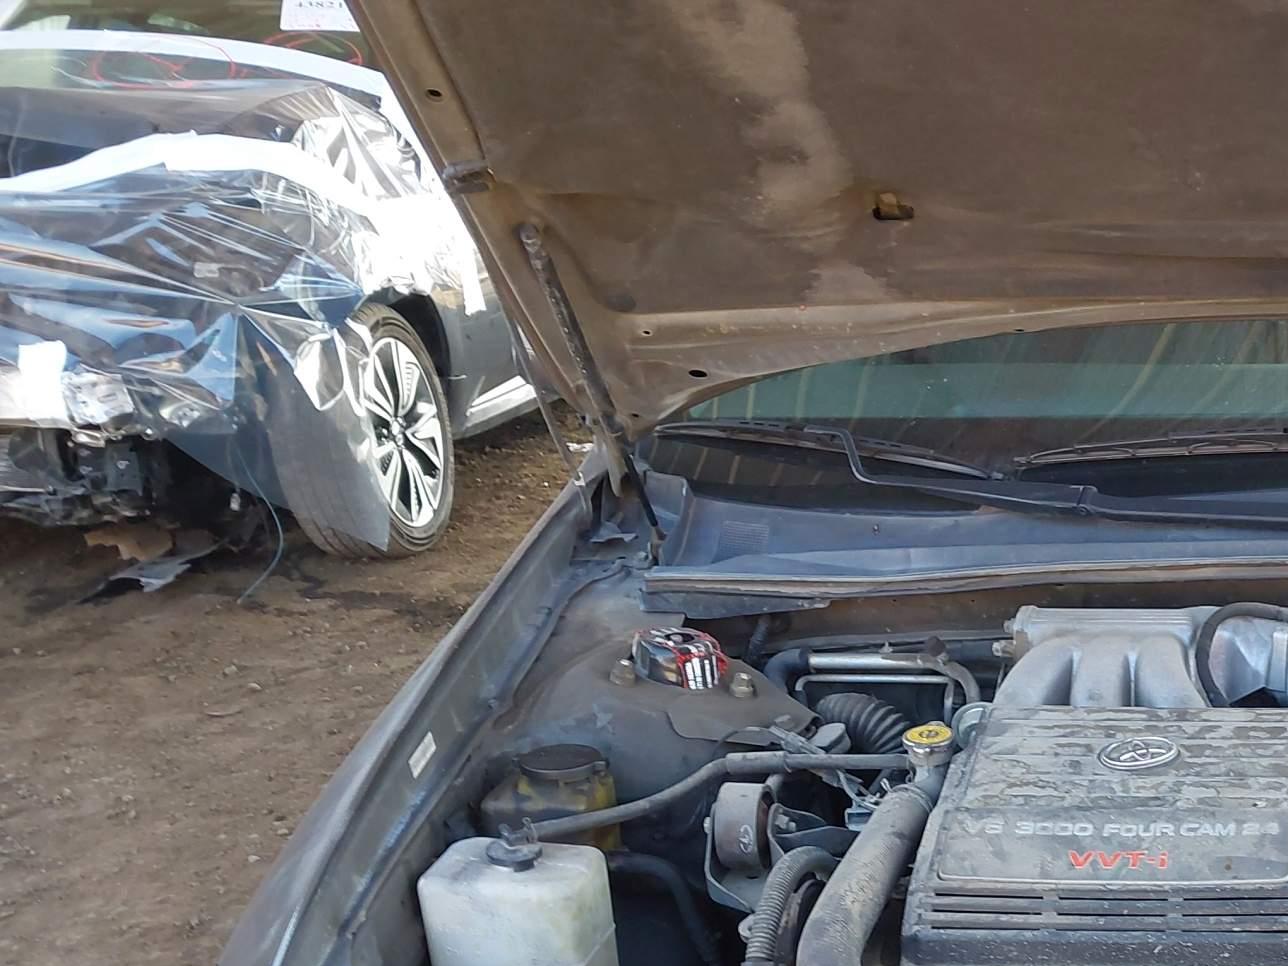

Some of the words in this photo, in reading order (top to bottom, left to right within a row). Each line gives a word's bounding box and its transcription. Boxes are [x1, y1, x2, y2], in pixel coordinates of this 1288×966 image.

[1014, 821, 1095, 837] 3000
[1102, 822, 1176, 838] FOUR
[1178, 822, 1237, 838] CAM
[1240, 822, 1281, 836] 24
[1067, 850, 1169, 869] VVT-i
